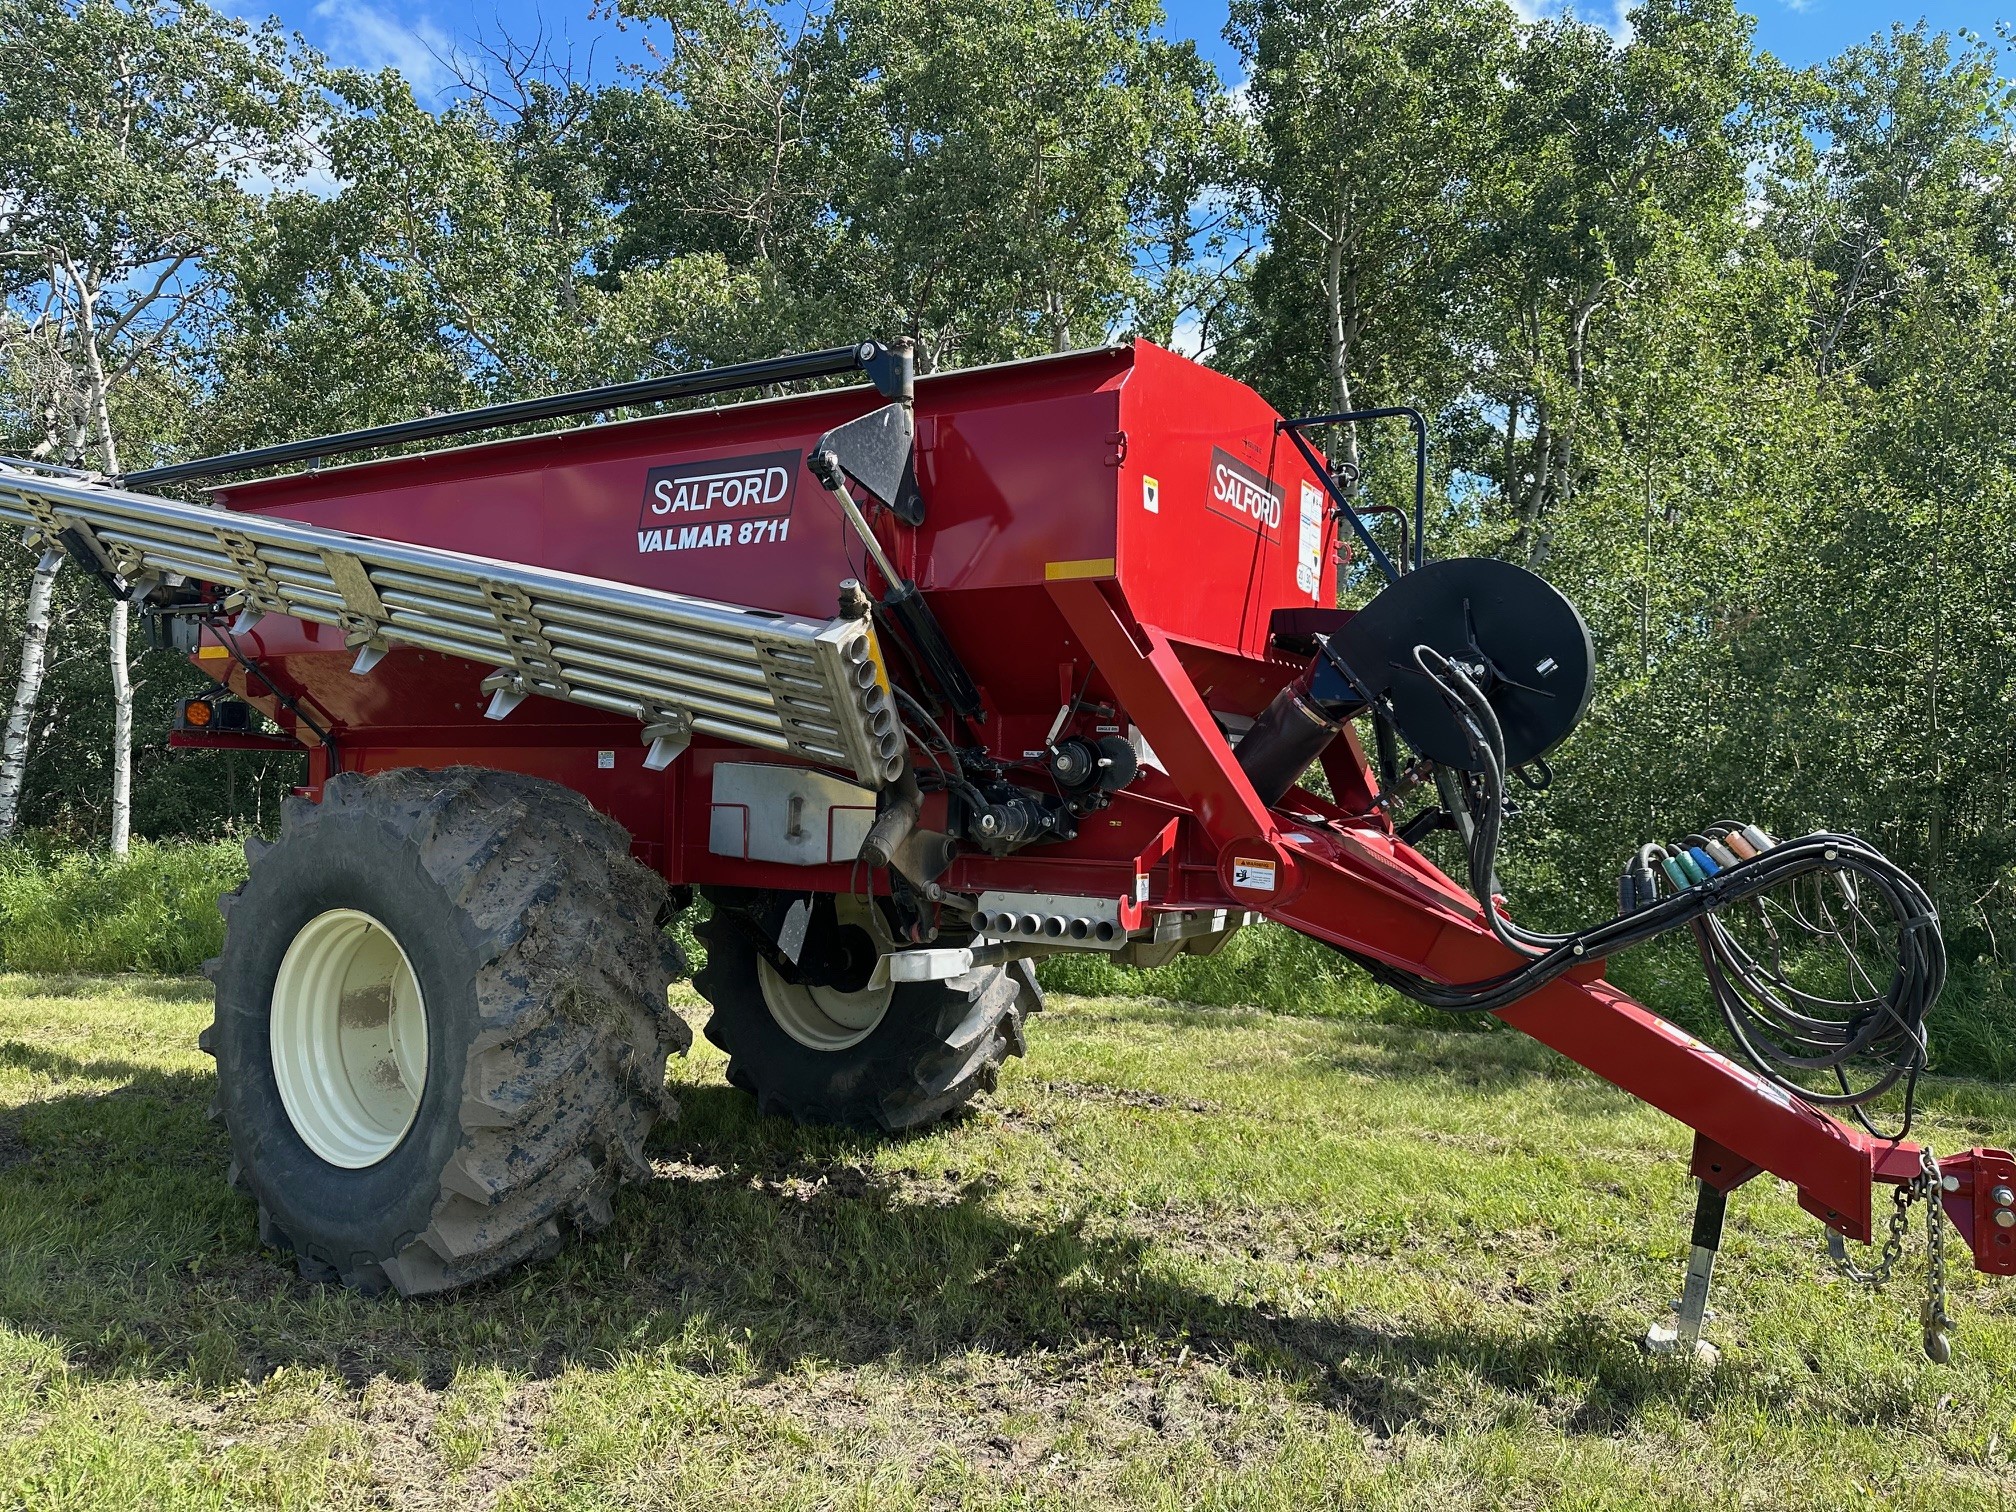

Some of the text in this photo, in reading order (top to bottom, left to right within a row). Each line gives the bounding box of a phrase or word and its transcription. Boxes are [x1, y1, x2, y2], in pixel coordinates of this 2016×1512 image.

[651, 466, 788, 515] SALFORD
[1213, 463, 1281, 529] SALFORD
[637, 518, 790, 554] VALMAR 8711
